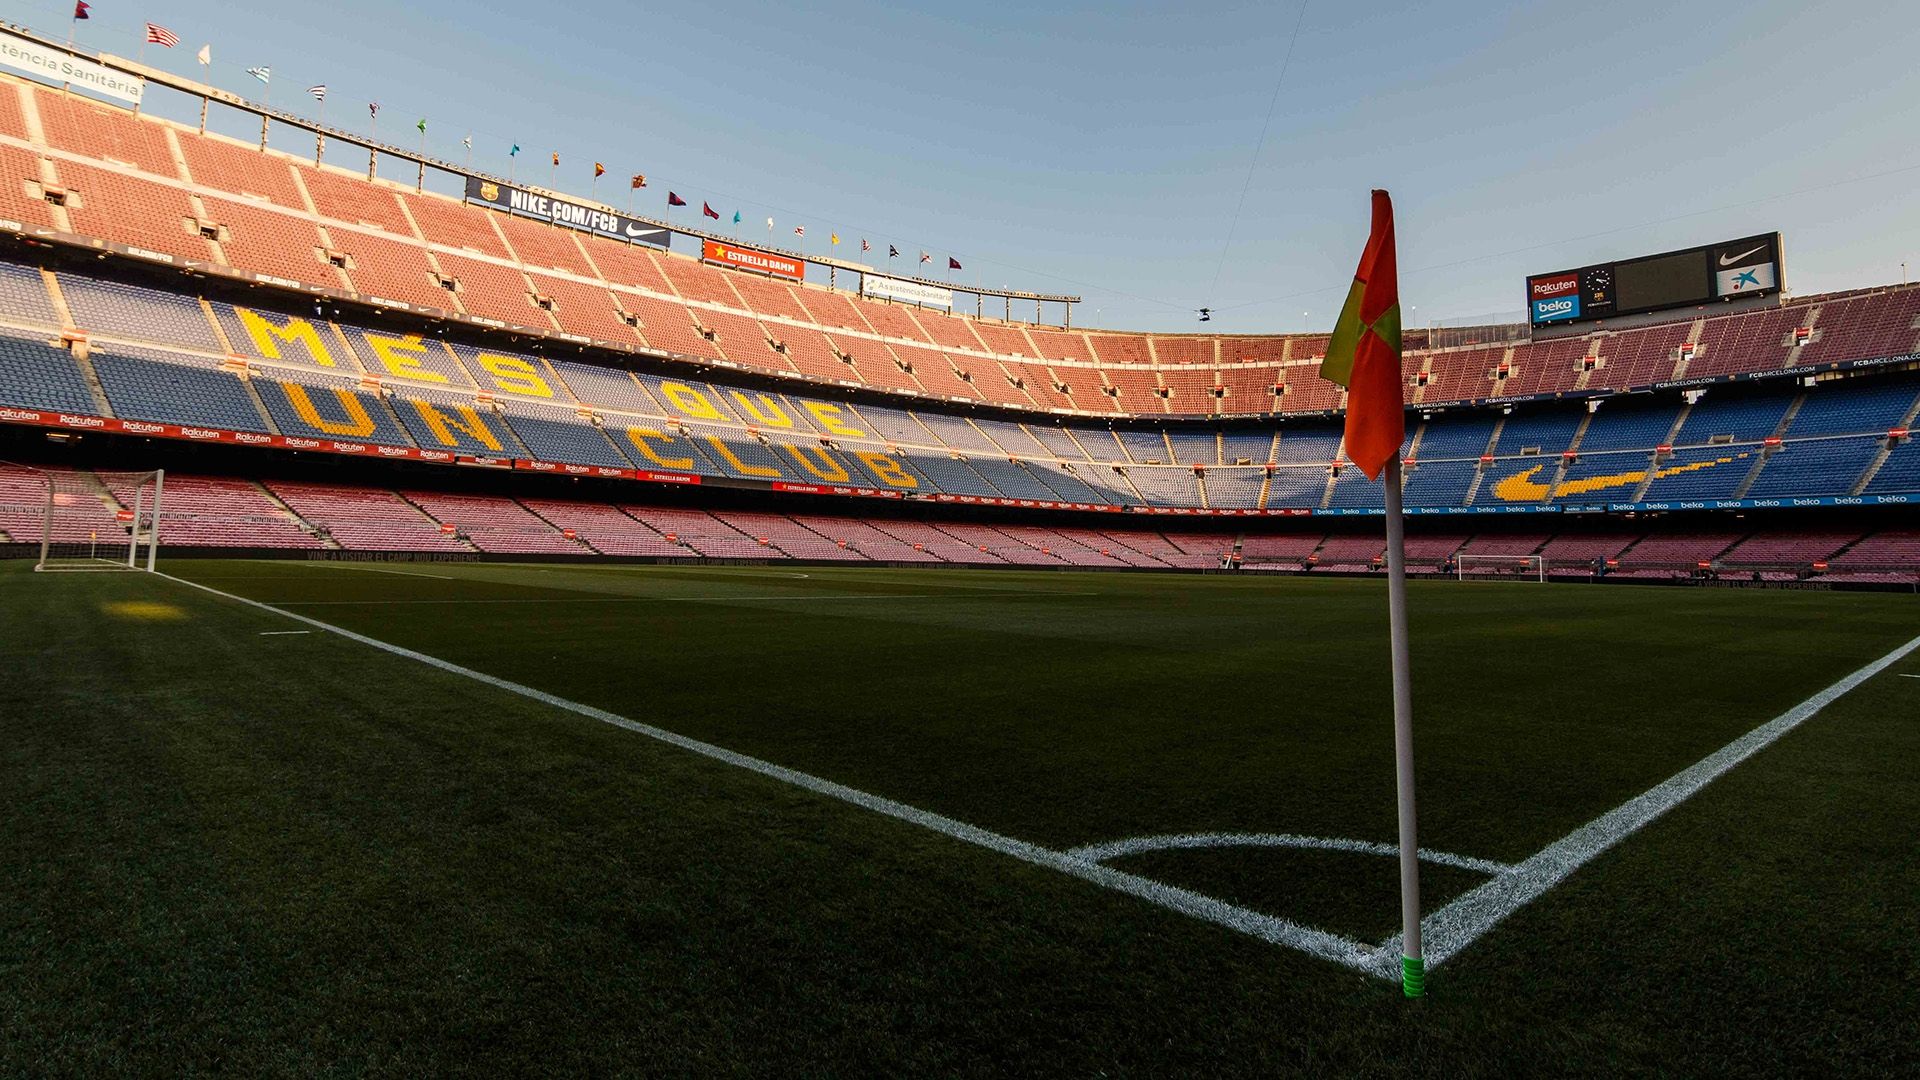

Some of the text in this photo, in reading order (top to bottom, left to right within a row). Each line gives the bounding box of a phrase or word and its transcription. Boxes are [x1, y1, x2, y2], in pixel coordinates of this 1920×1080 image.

[511, 189, 618, 233] NIKE.COM/FCB
[727, 250, 795, 273] ESTRELLA DAMM
[1534, 280, 1576, 294] Rakuten
[1538, 300, 1572, 313] beko
[1749, 366, 1816, 379] FCBARCELONA.COM
[1655, 377, 1716, 389] FCBARCELONA.COM
[660, 381, 866, 437] QUE
[60, 415, 104, 427] Rakuten
[123, 421, 164, 433] Rakuten
[181, 428, 220, 438] Rakuten
[236, 433, 272, 443] Rakuten
[286, 437, 320, 447] Rakuten
[334, 442, 366, 452] Rakuten
[378, 446, 408, 456] Rakuten
[420, 450, 449, 459] Rakuten
[281, 381, 919, 488] UN CLUB
[1793, 498, 1820, 506] beko
[1834, 497, 1862, 505] beko
[1877, 495, 1907, 503] beko
[307, 551, 481, 563] VINE A VISITAR EL CAMP NOU EXPERIENCE
